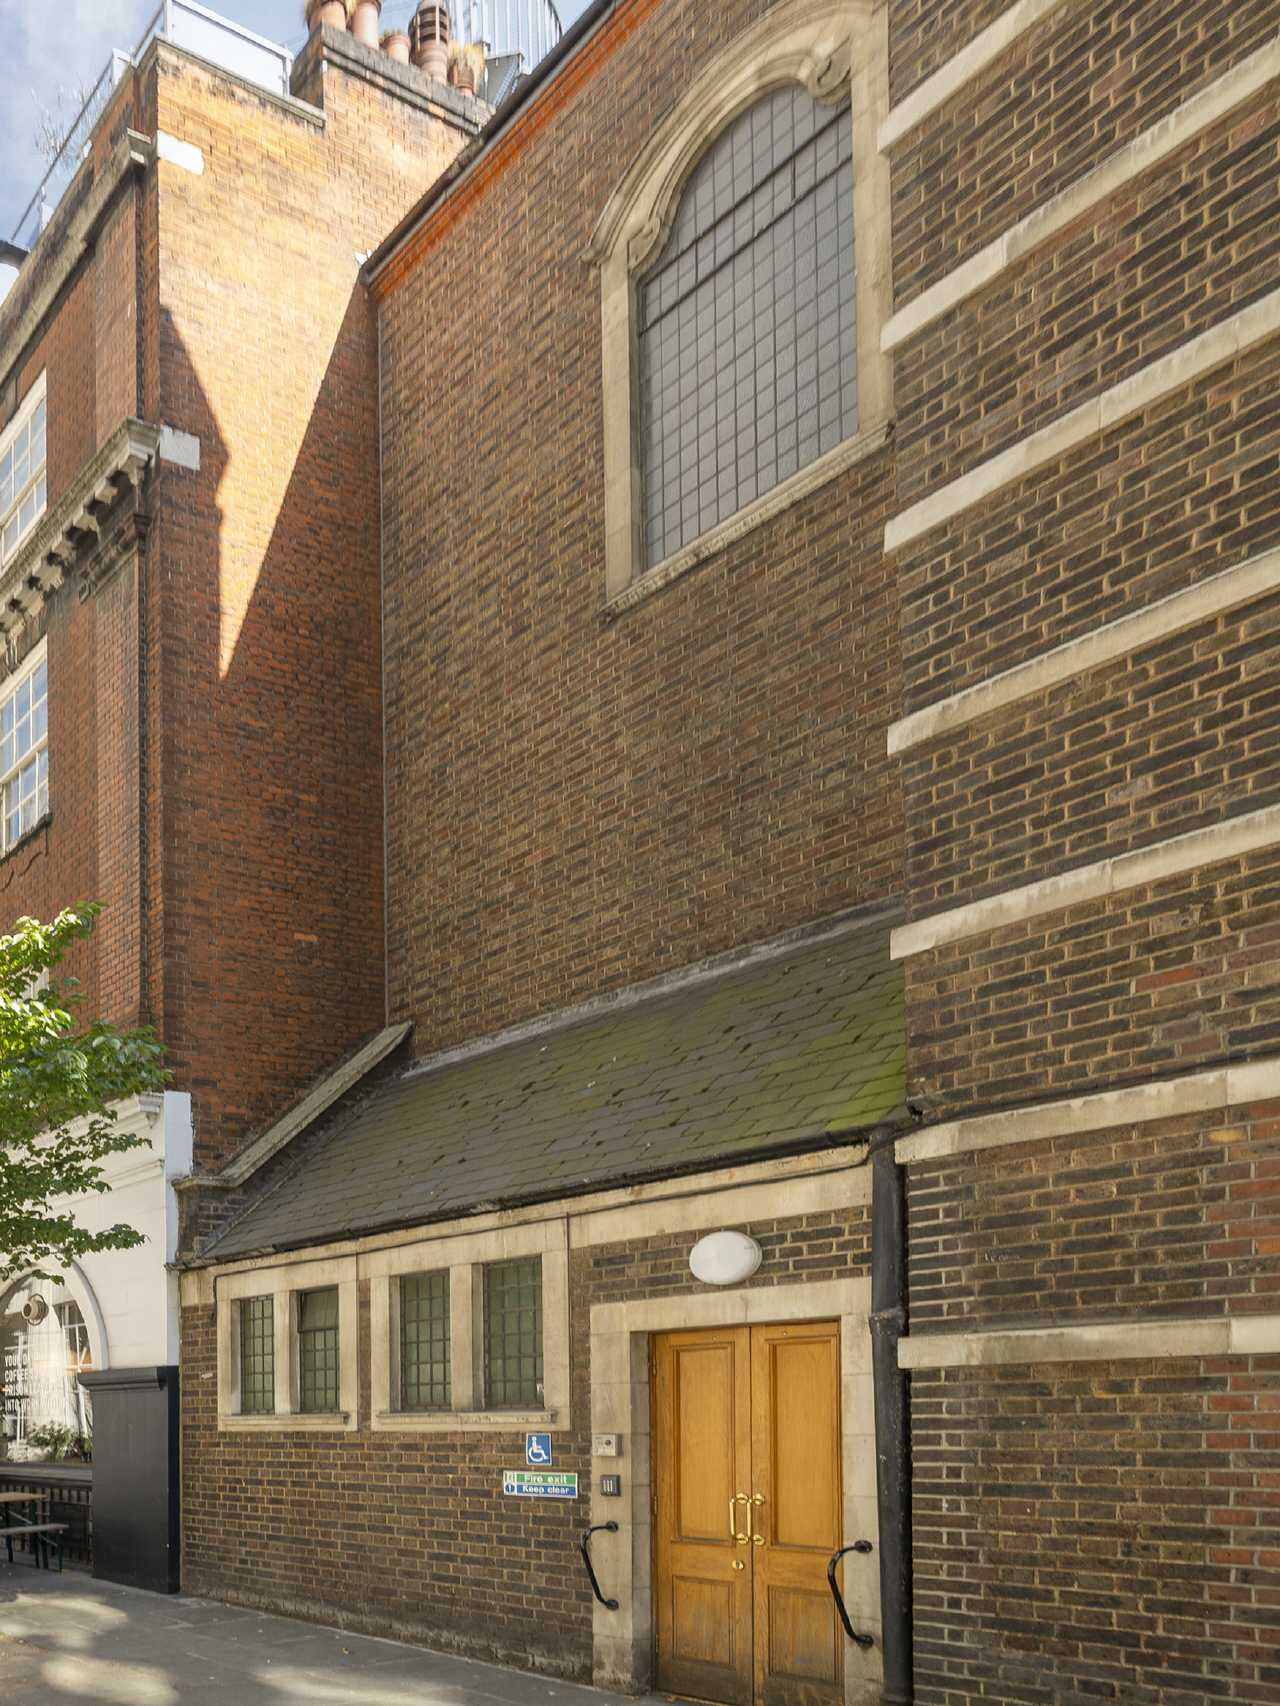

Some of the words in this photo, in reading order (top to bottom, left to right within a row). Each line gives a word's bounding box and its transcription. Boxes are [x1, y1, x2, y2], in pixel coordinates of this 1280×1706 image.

[524, 1474, 543, 1483] Fire
[547, 1474, 567, 1484] exit
[523, 1485, 544, 1494] Keep
[547, 1485, 570, 1494] clear
